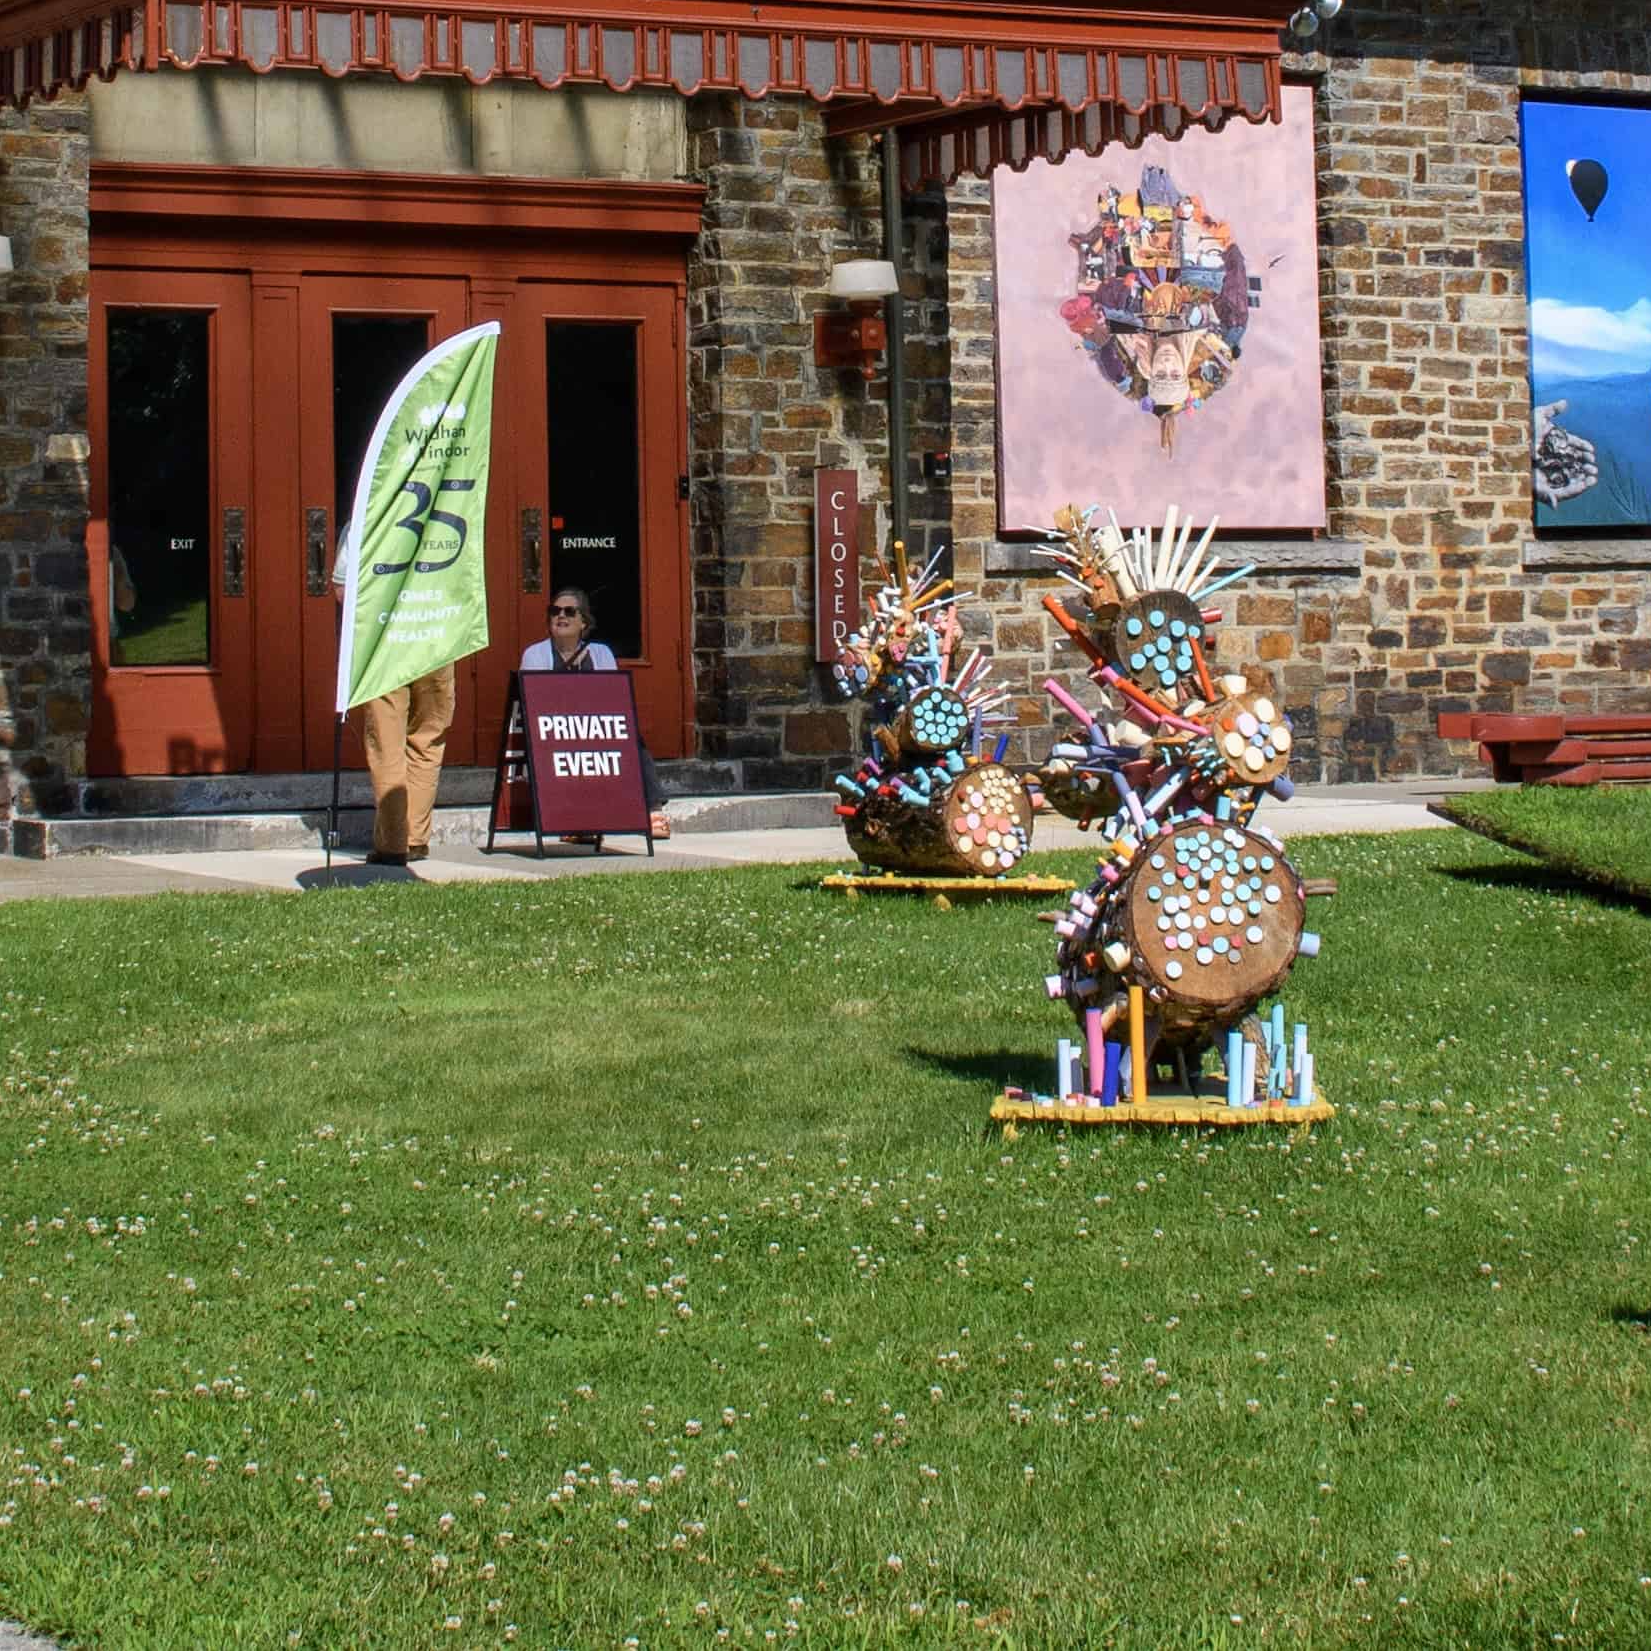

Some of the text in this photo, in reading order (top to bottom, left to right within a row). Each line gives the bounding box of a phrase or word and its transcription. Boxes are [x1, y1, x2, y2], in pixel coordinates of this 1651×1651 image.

[372, 479, 476, 575] 35
[171, 538, 197, 550] EXIT
[562, 537, 616, 549] ENTRANCE
[831, 490, 847, 640] CLOSED
[378, 604, 462, 625] CMMUNITY
[538, 715, 629, 741] PRIVATE
[553, 751, 621, 777] EVENT
